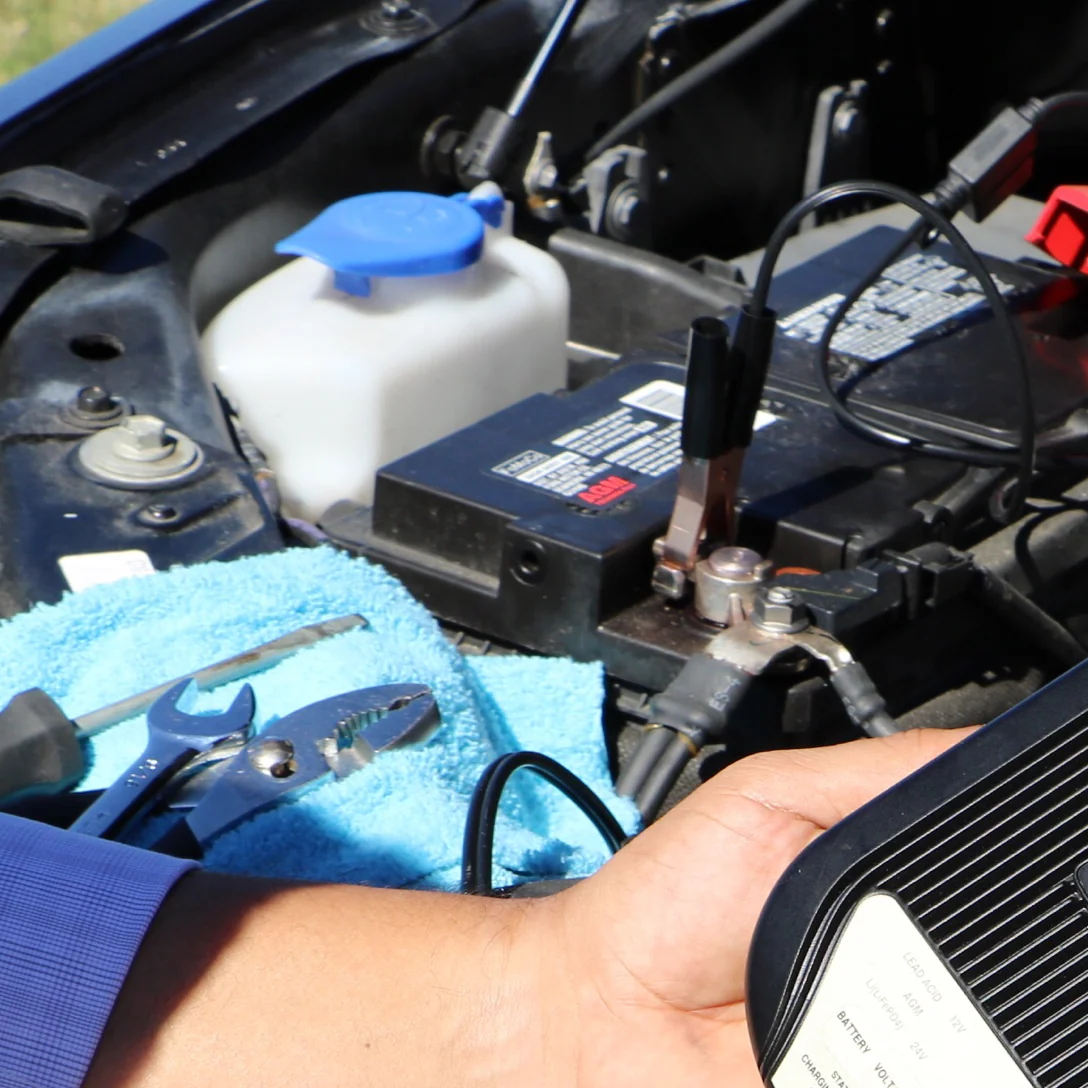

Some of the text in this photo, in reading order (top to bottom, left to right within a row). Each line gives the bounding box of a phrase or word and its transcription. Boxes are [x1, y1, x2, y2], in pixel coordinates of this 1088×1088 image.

[902, 951, 968, 1035] LEAD ACID 12V
[902, 992, 924, 1017] AGM
[836, 1010, 872, 1055] BATTERY
[909, 1041, 929, 1061] 24V
